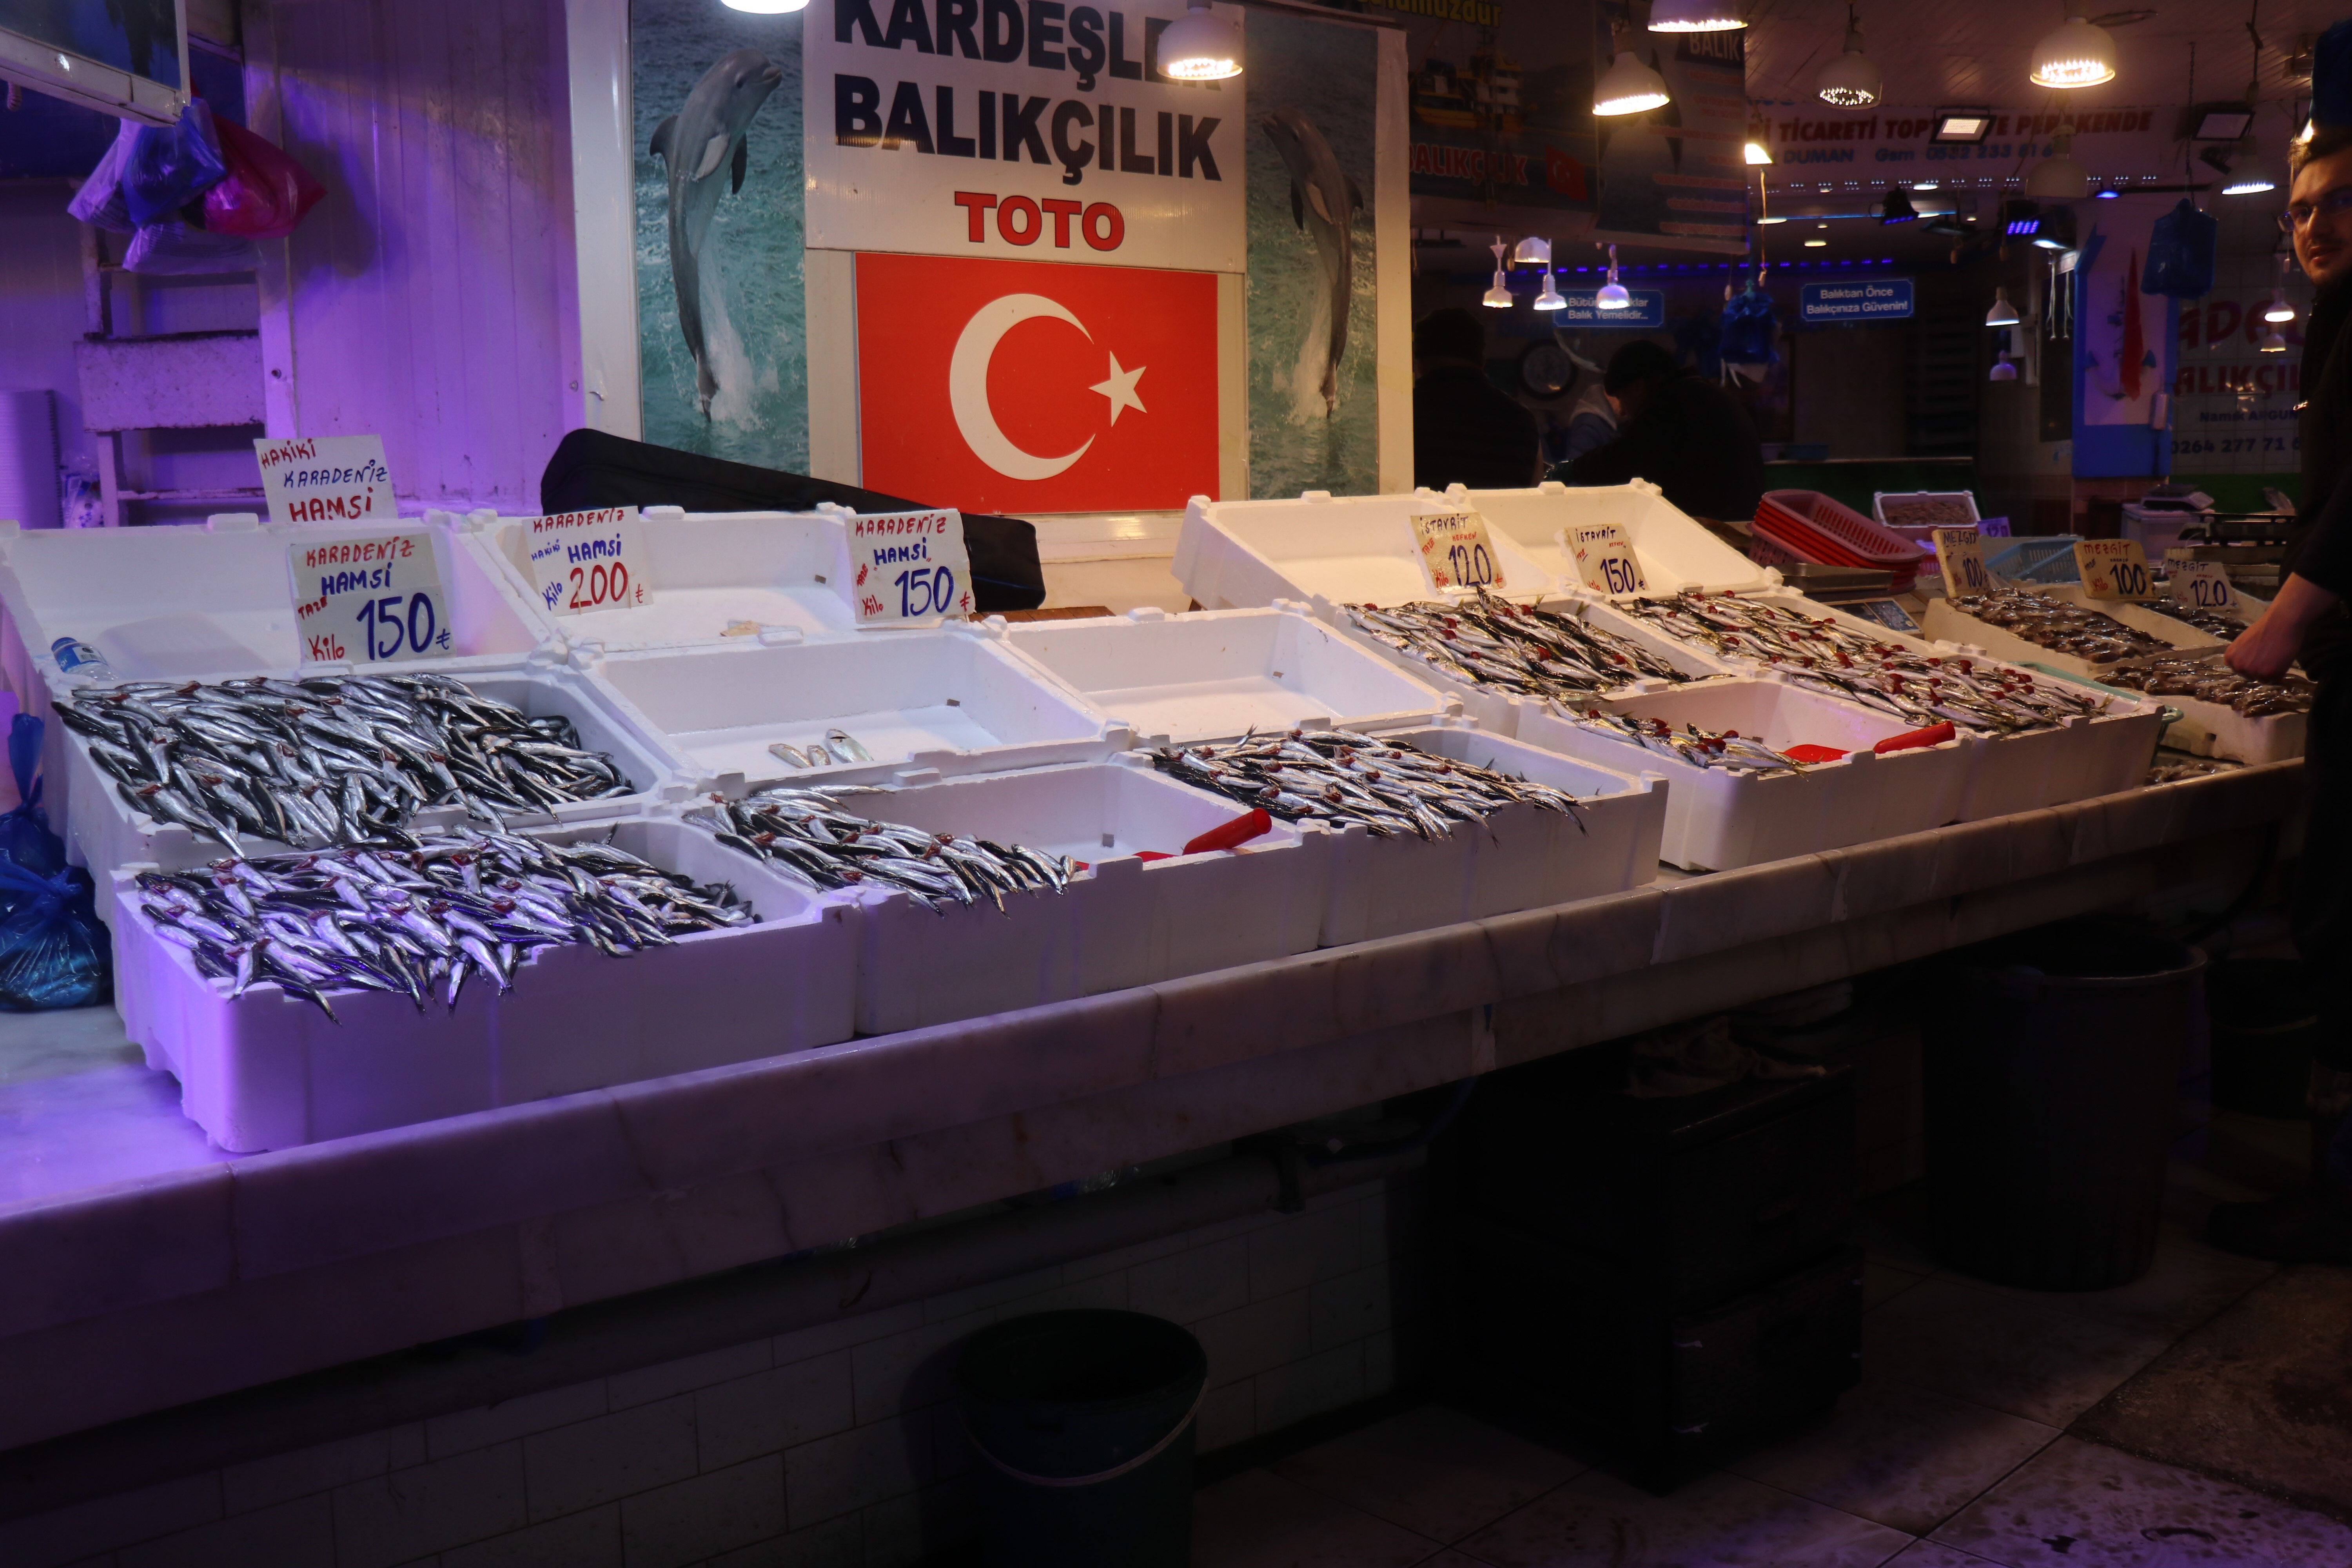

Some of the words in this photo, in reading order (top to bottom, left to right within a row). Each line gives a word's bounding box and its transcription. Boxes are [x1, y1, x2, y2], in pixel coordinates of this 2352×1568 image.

[834, 0, 1221, 91] KARDEŞL
[834, 73, 1223, 185] BALIKÇILIK
[1409, 143, 1528, 186] ALIKÇILIK
[953, 191, 1125, 252] TOTO
[1862, 300, 1908, 312] Güvenin!
[1865, 285, 1894, 298] Önce
[261, 438, 316, 469] HAKİKİ
[2221, 437, 2256, 453] 277
[2262, 437, 2285, 451] 71
[284, 459, 388, 488] KARADENİZ
[289, 487, 372, 522] HAMSİ
[855, 514, 947, 538] KARADENİZ
[306, 536, 415, 568] KARADENİZ
[568, 533, 622, 564] HAMSİ
[1448, 544, 1492, 586] 120
[2084, 542, 2131, 556] MEZGİT
[321, 562, 392, 596] HAMSİ
[542, 581, 563, 611] Kilo
[570, 562, 628, 609] 200
[894, 566, 954, 617] 150
[1600, 558, 1635, 594] 150
[2109, 563, 2147, 595] 100
[356, 592, 435, 661] 150
